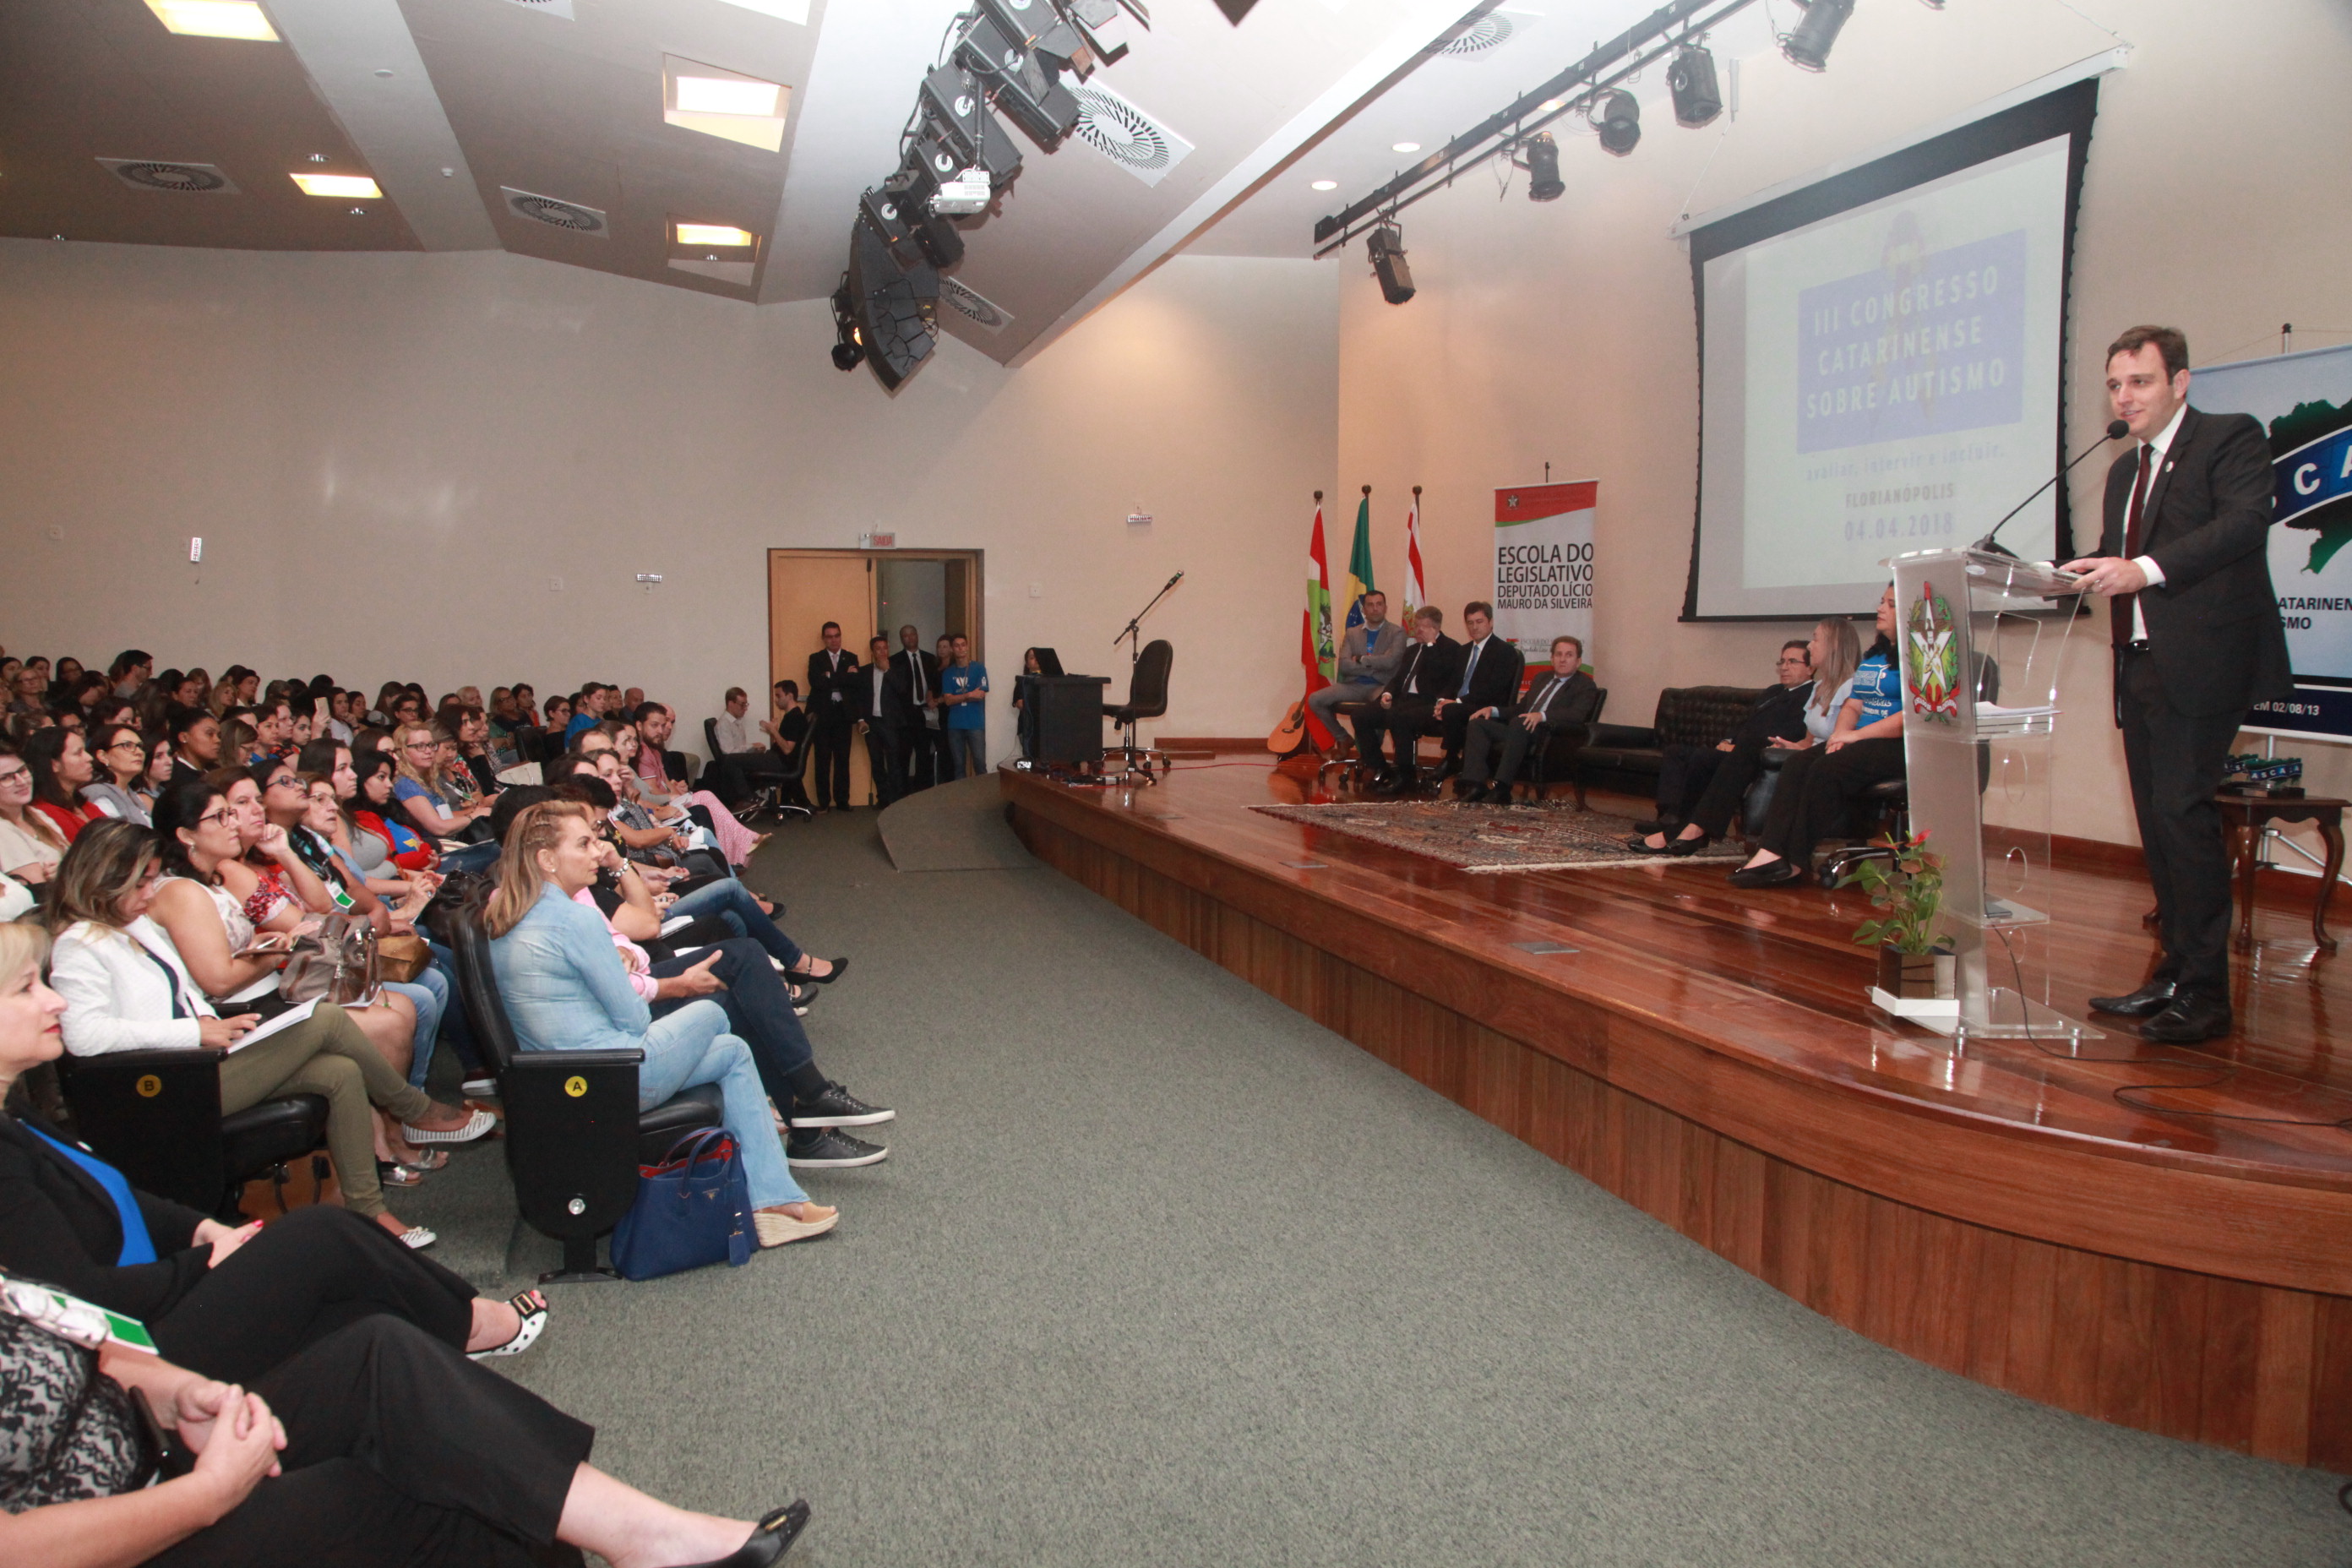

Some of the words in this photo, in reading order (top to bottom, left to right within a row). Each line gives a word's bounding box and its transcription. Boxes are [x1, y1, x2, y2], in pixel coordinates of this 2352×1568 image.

[1813, 306, 1839, 337] III
[1851, 265, 1997, 327] CONGRESSO
[1819, 315, 1982, 376] CATARINENSE
[1806, 382, 1876, 419] SOBRE
[1888, 357, 2005, 406] AUTISMO
[1845, 482, 1956, 508] FLORIANÓPOLIS
[1844, 511, 1953, 542] 04.04.2018
[1498, 544, 1561, 564] ESCOLA
[1567, 542, 1593, 563] DO
[1498, 564, 1593, 583] LEGISLATIVO
[1497, 584, 1560, 597] DEPUTADO
[1562, 581, 1593, 596] LÍCIO
[1497, 598, 1532, 609] MAURO
[1534, 598, 1548, 608] DA
[1550, 597, 1592, 608] SILVEIRA
[2278, 597, 2352, 611] ATARINEN
[2280, 617, 2312, 629] SMO
[2273, 702, 2320, 716] 02/08/13
[144, 1080, 155, 1092] B
[572, 1081, 583, 1092] A
